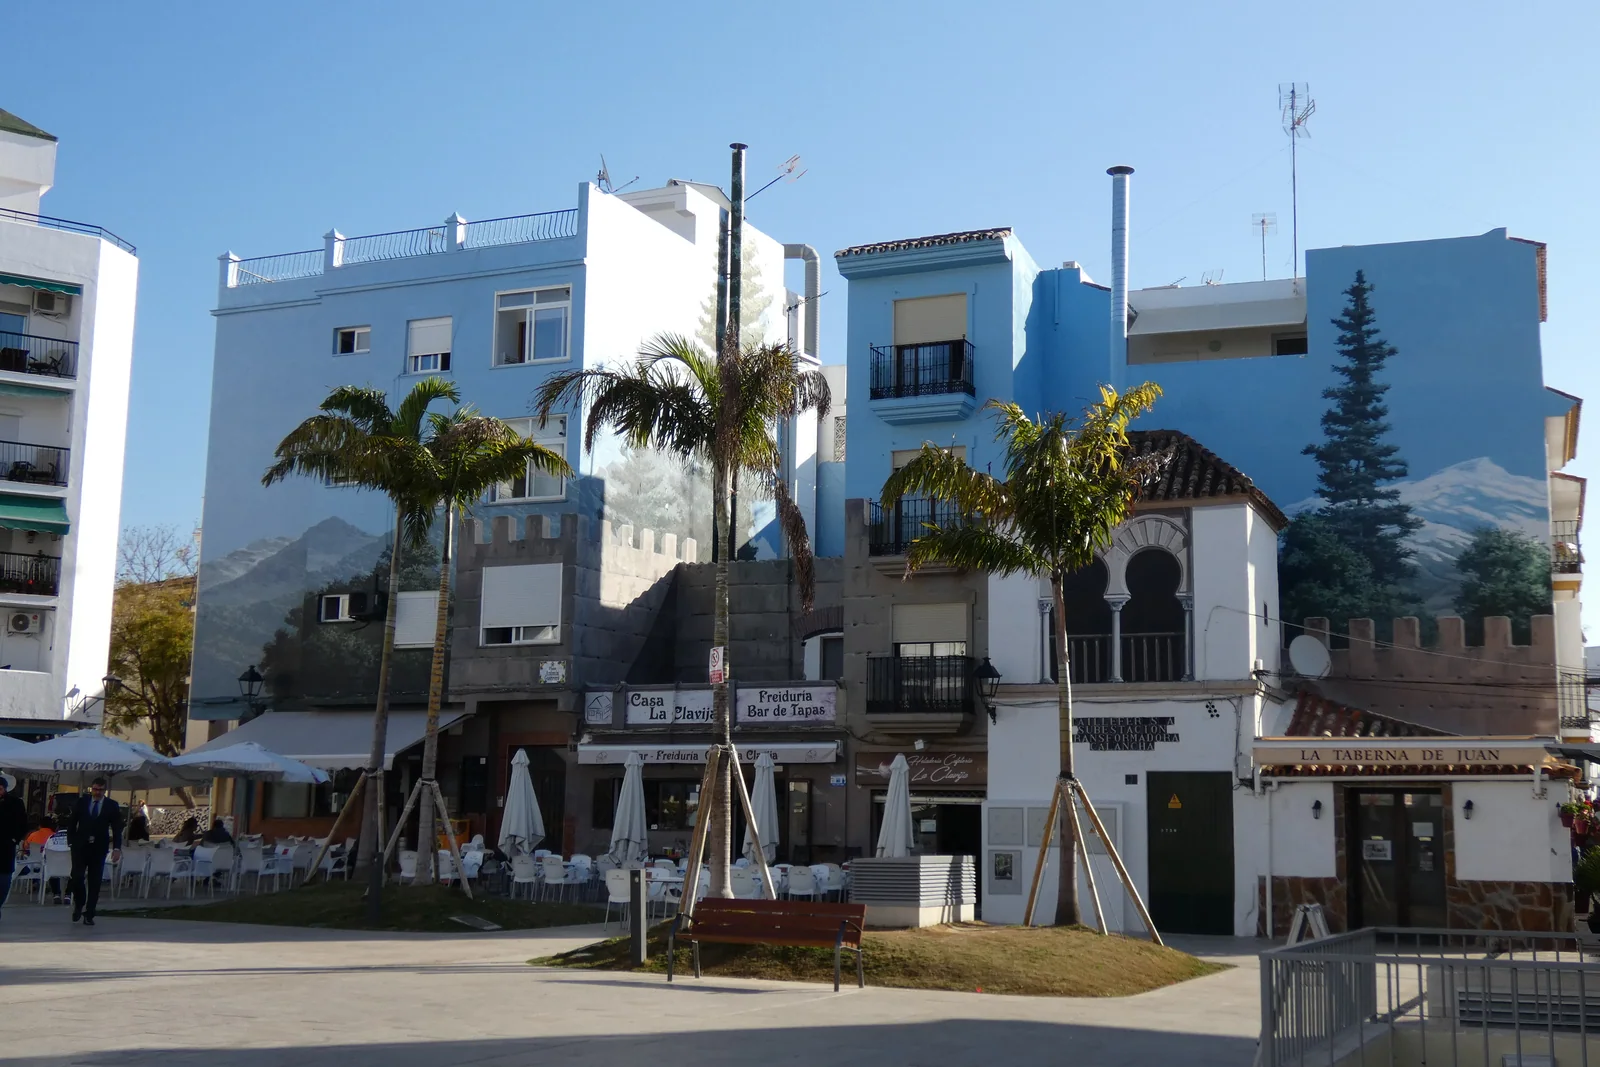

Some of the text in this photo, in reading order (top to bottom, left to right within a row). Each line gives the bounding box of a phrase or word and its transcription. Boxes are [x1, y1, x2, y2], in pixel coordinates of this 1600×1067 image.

[630, 693, 664, 707] Casa
[759, 690, 812, 703] Freiduría
[649, 706, 667, 721] La
[747, 703, 825, 718] Bar de Tapas
[1073, 733, 1180, 743] RANSFORMADORA
[1090, 742, 1154, 751] CALANCHA
[656, 750, 699, 761] Freiduría
[1301, 750, 1501, 762] LA TABERNA DE JUAN
[911, 767, 928, 782] La
